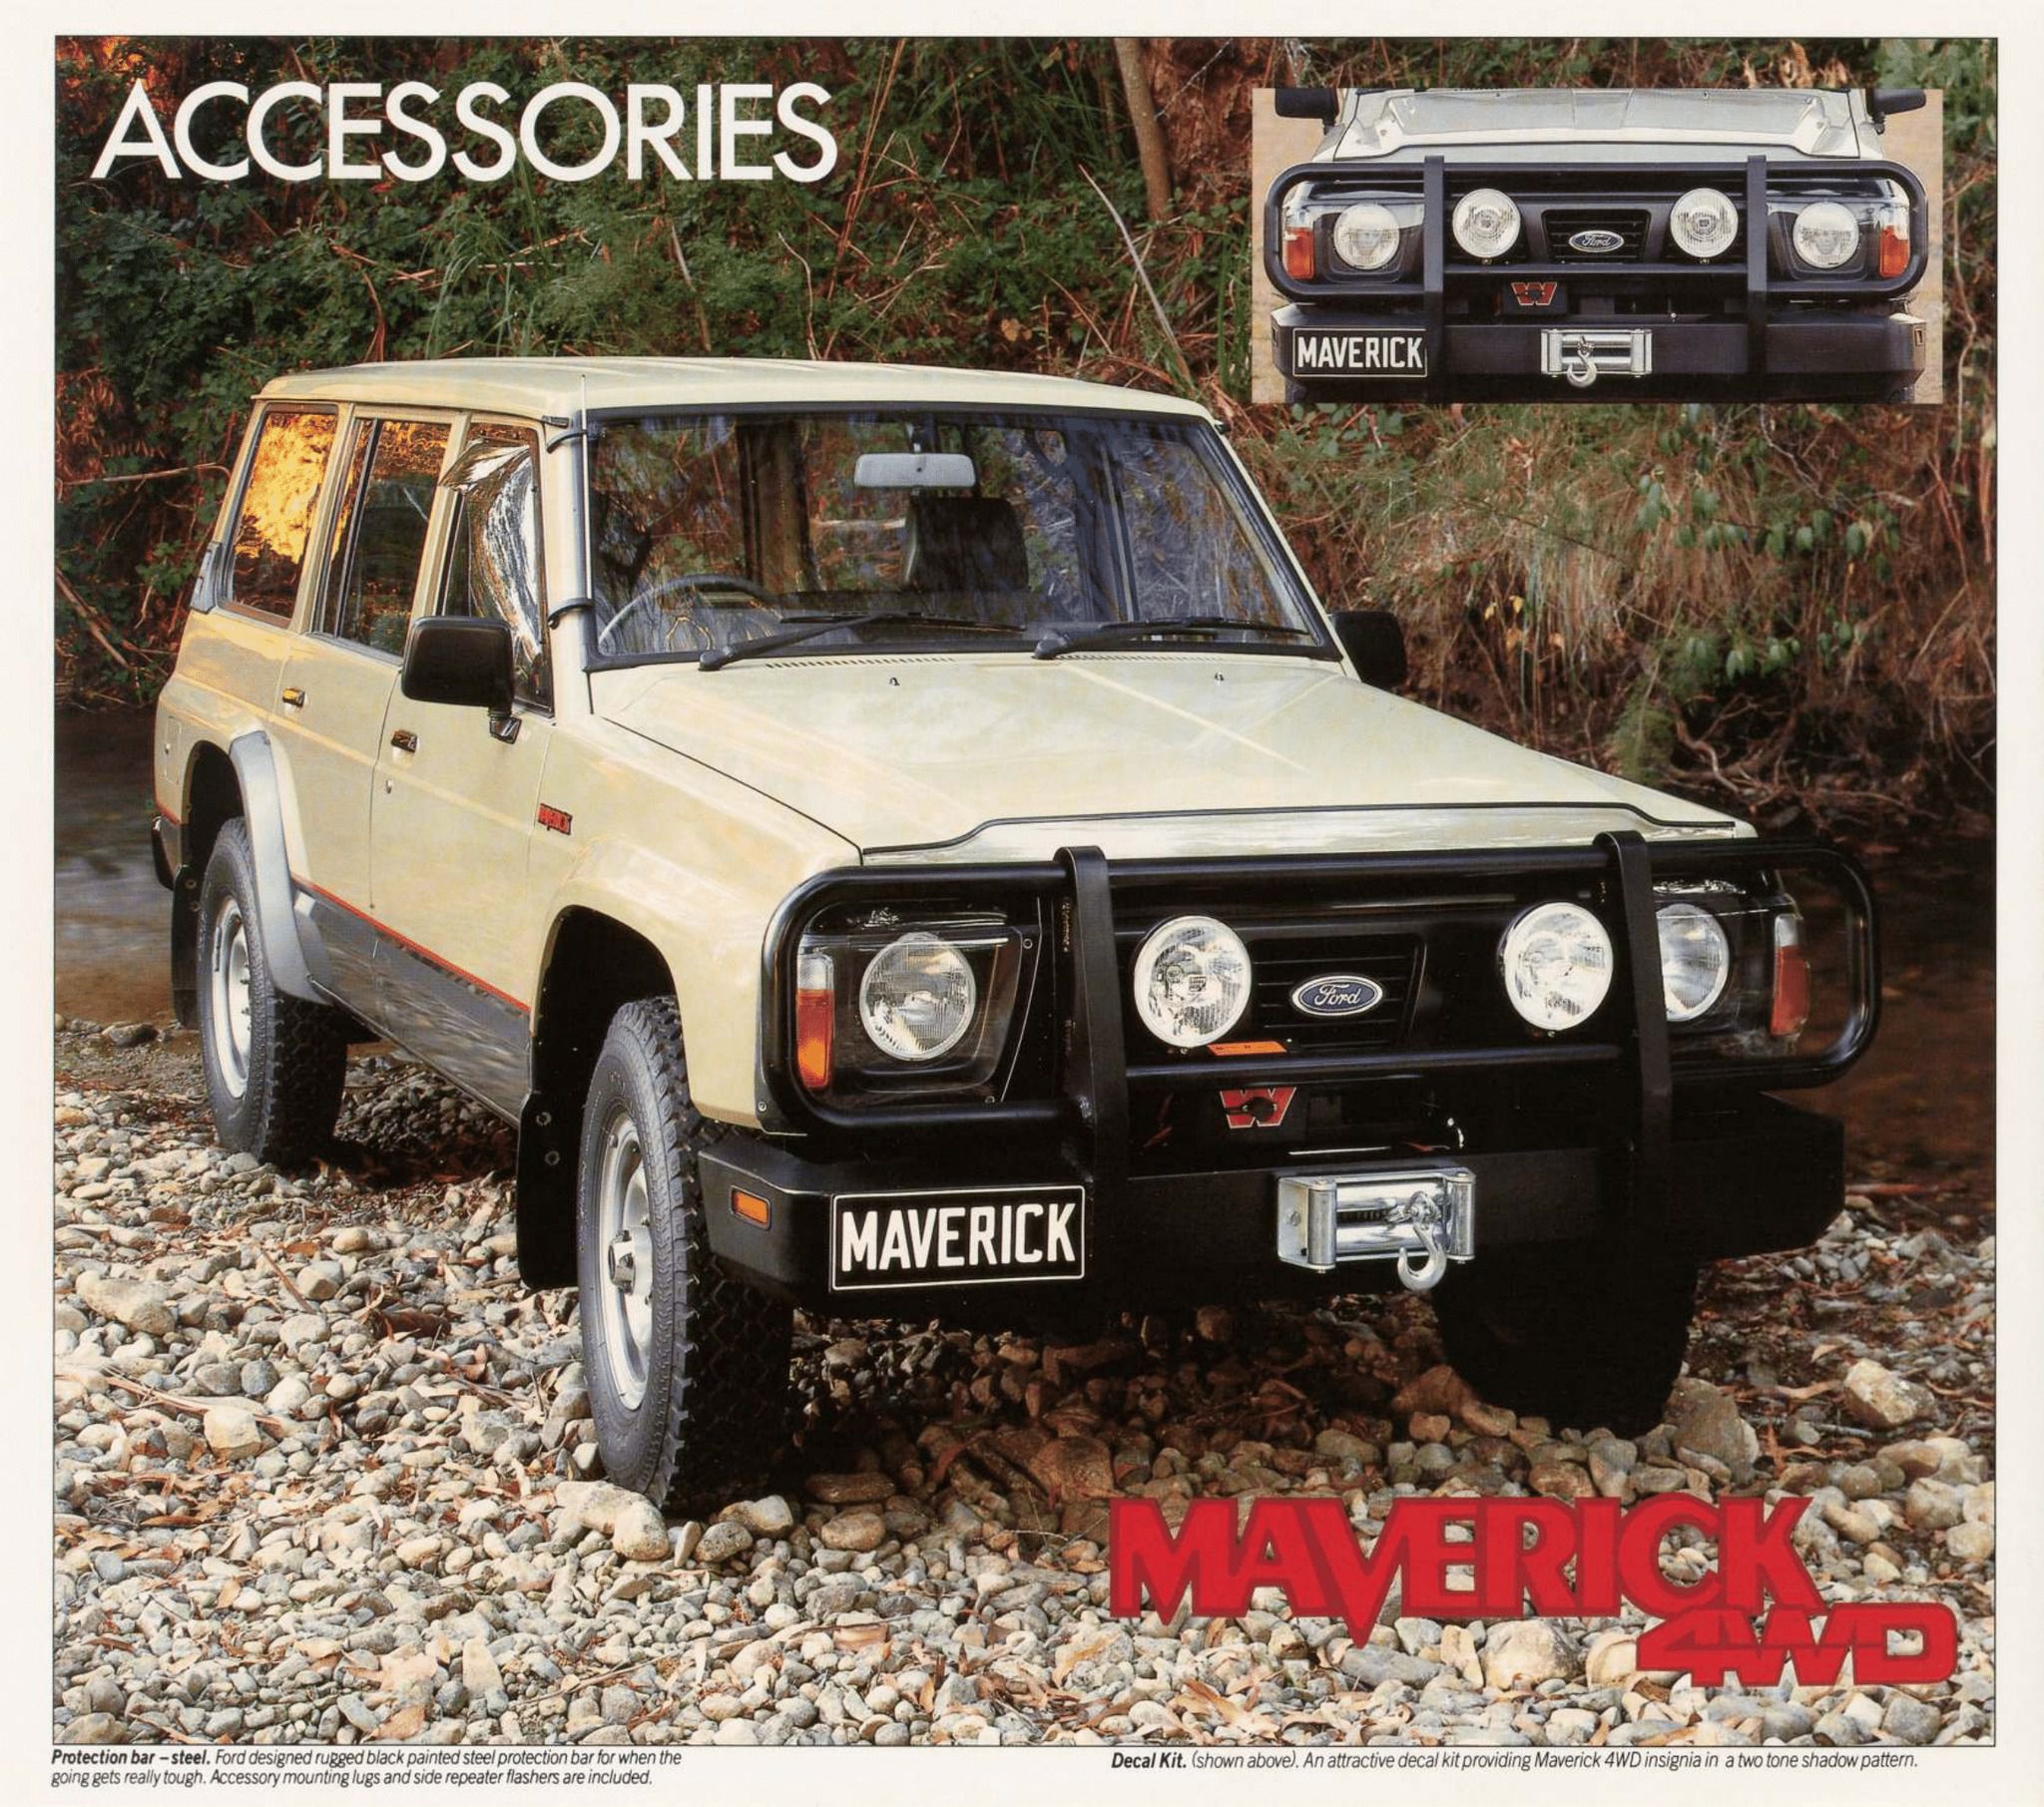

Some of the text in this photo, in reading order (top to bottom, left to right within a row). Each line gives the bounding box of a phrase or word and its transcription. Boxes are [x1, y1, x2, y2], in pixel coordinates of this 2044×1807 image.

[1582, 232, 1611, 247] Ford
[1297, 337, 1423, 368] MAVERICK
[1313, 983, 1361, 1007] Ford
[840, 1200, 1077, 1273] MAVERICK
